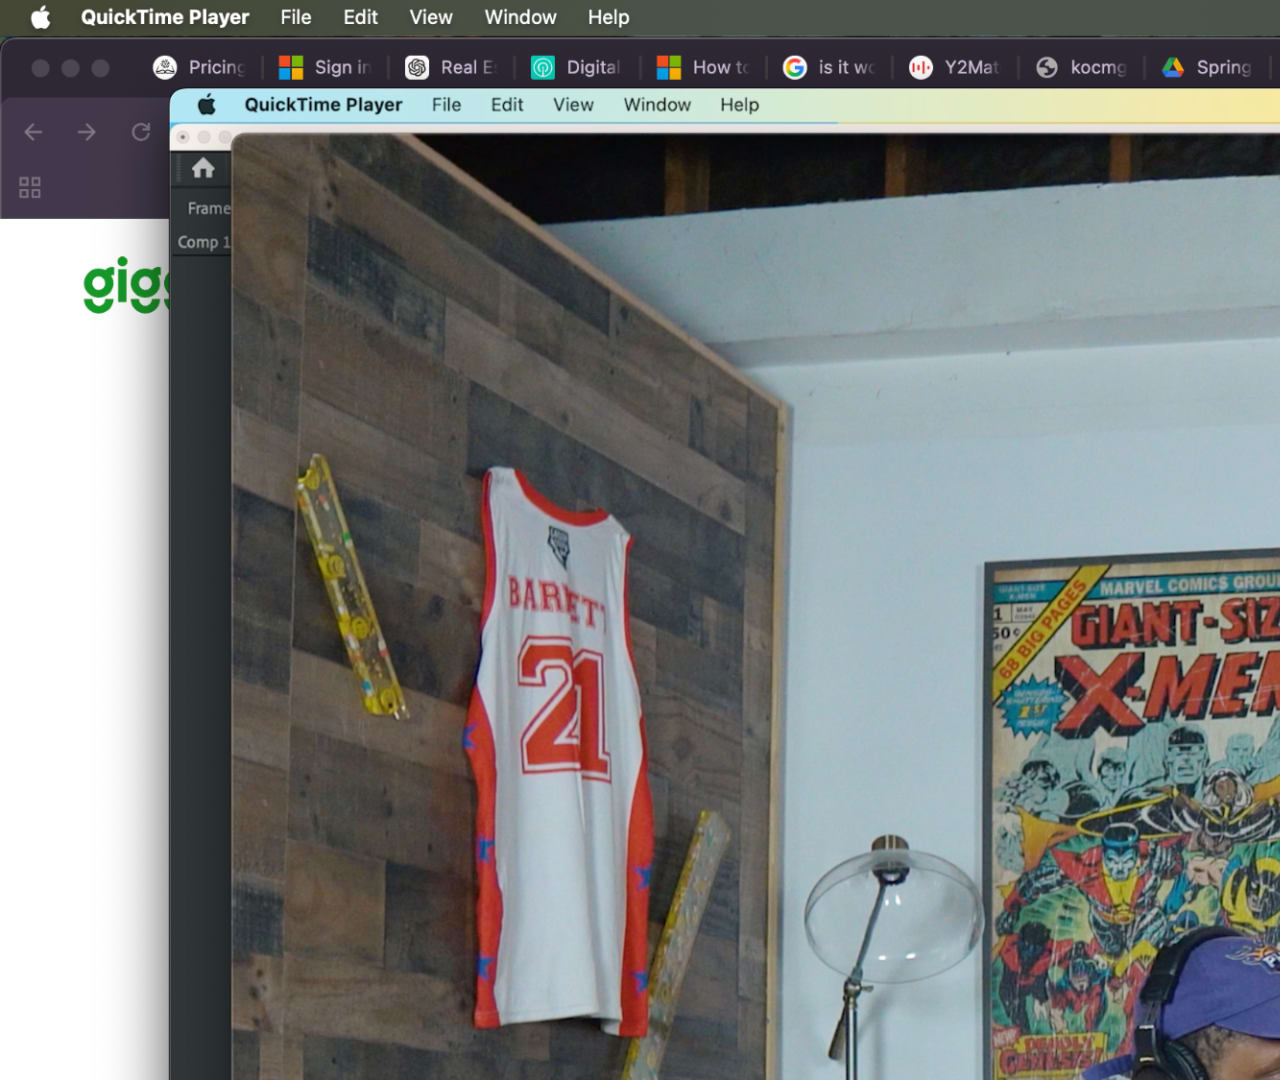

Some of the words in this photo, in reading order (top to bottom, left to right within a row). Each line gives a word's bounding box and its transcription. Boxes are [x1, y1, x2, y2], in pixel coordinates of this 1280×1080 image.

[81, 8, 184, 26] QuickTime
[190, 8, 250, 28] Player
[282, 9, 311, 24] File
[344, 9, 378, 24] Edit
[410, 9, 453, 24] View
[485, 9, 557, 24] Window
[589, 9, 630, 28] Help
[190, 59, 243, 77] Pricing
[315, 59, 352, 80] Sign
[358, 59, 371, 74] in
[442, 59, 477, 75] Real
[568, 59, 620, 77] Digital
[694, 59, 731, 74] How
[819, 59, 833, 74] is
[838, 59, 849, 74] it
[945, 59, 999, 74] Y2Mat
[1072, 59, 1126, 77] kocmg
[1197, 59, 1251, 78] Spring
[245, 96, 341, 112] QuickTime
[347, 97, 403, 115] Player
[433, 97, 461, 112] File
[492, 97, 523, 112] Edit
[554, 97, 594, 112] View
[624, 97, 691, 112] Window
[721, 97, 759, 115] Help
[189, 202, 231, 214] Frame
[178, 235, 218, 251] Comp
[1100, 578, 1163, 596] MARVEL
[1167, 575, 1229, 592] COMICS
[1000, 658, 1019, 679] 68
[1018, 630, 1045, 659] BIG
[1041, 579, 1087, 629] PAGES
[518, 635, 612, 784] 21
